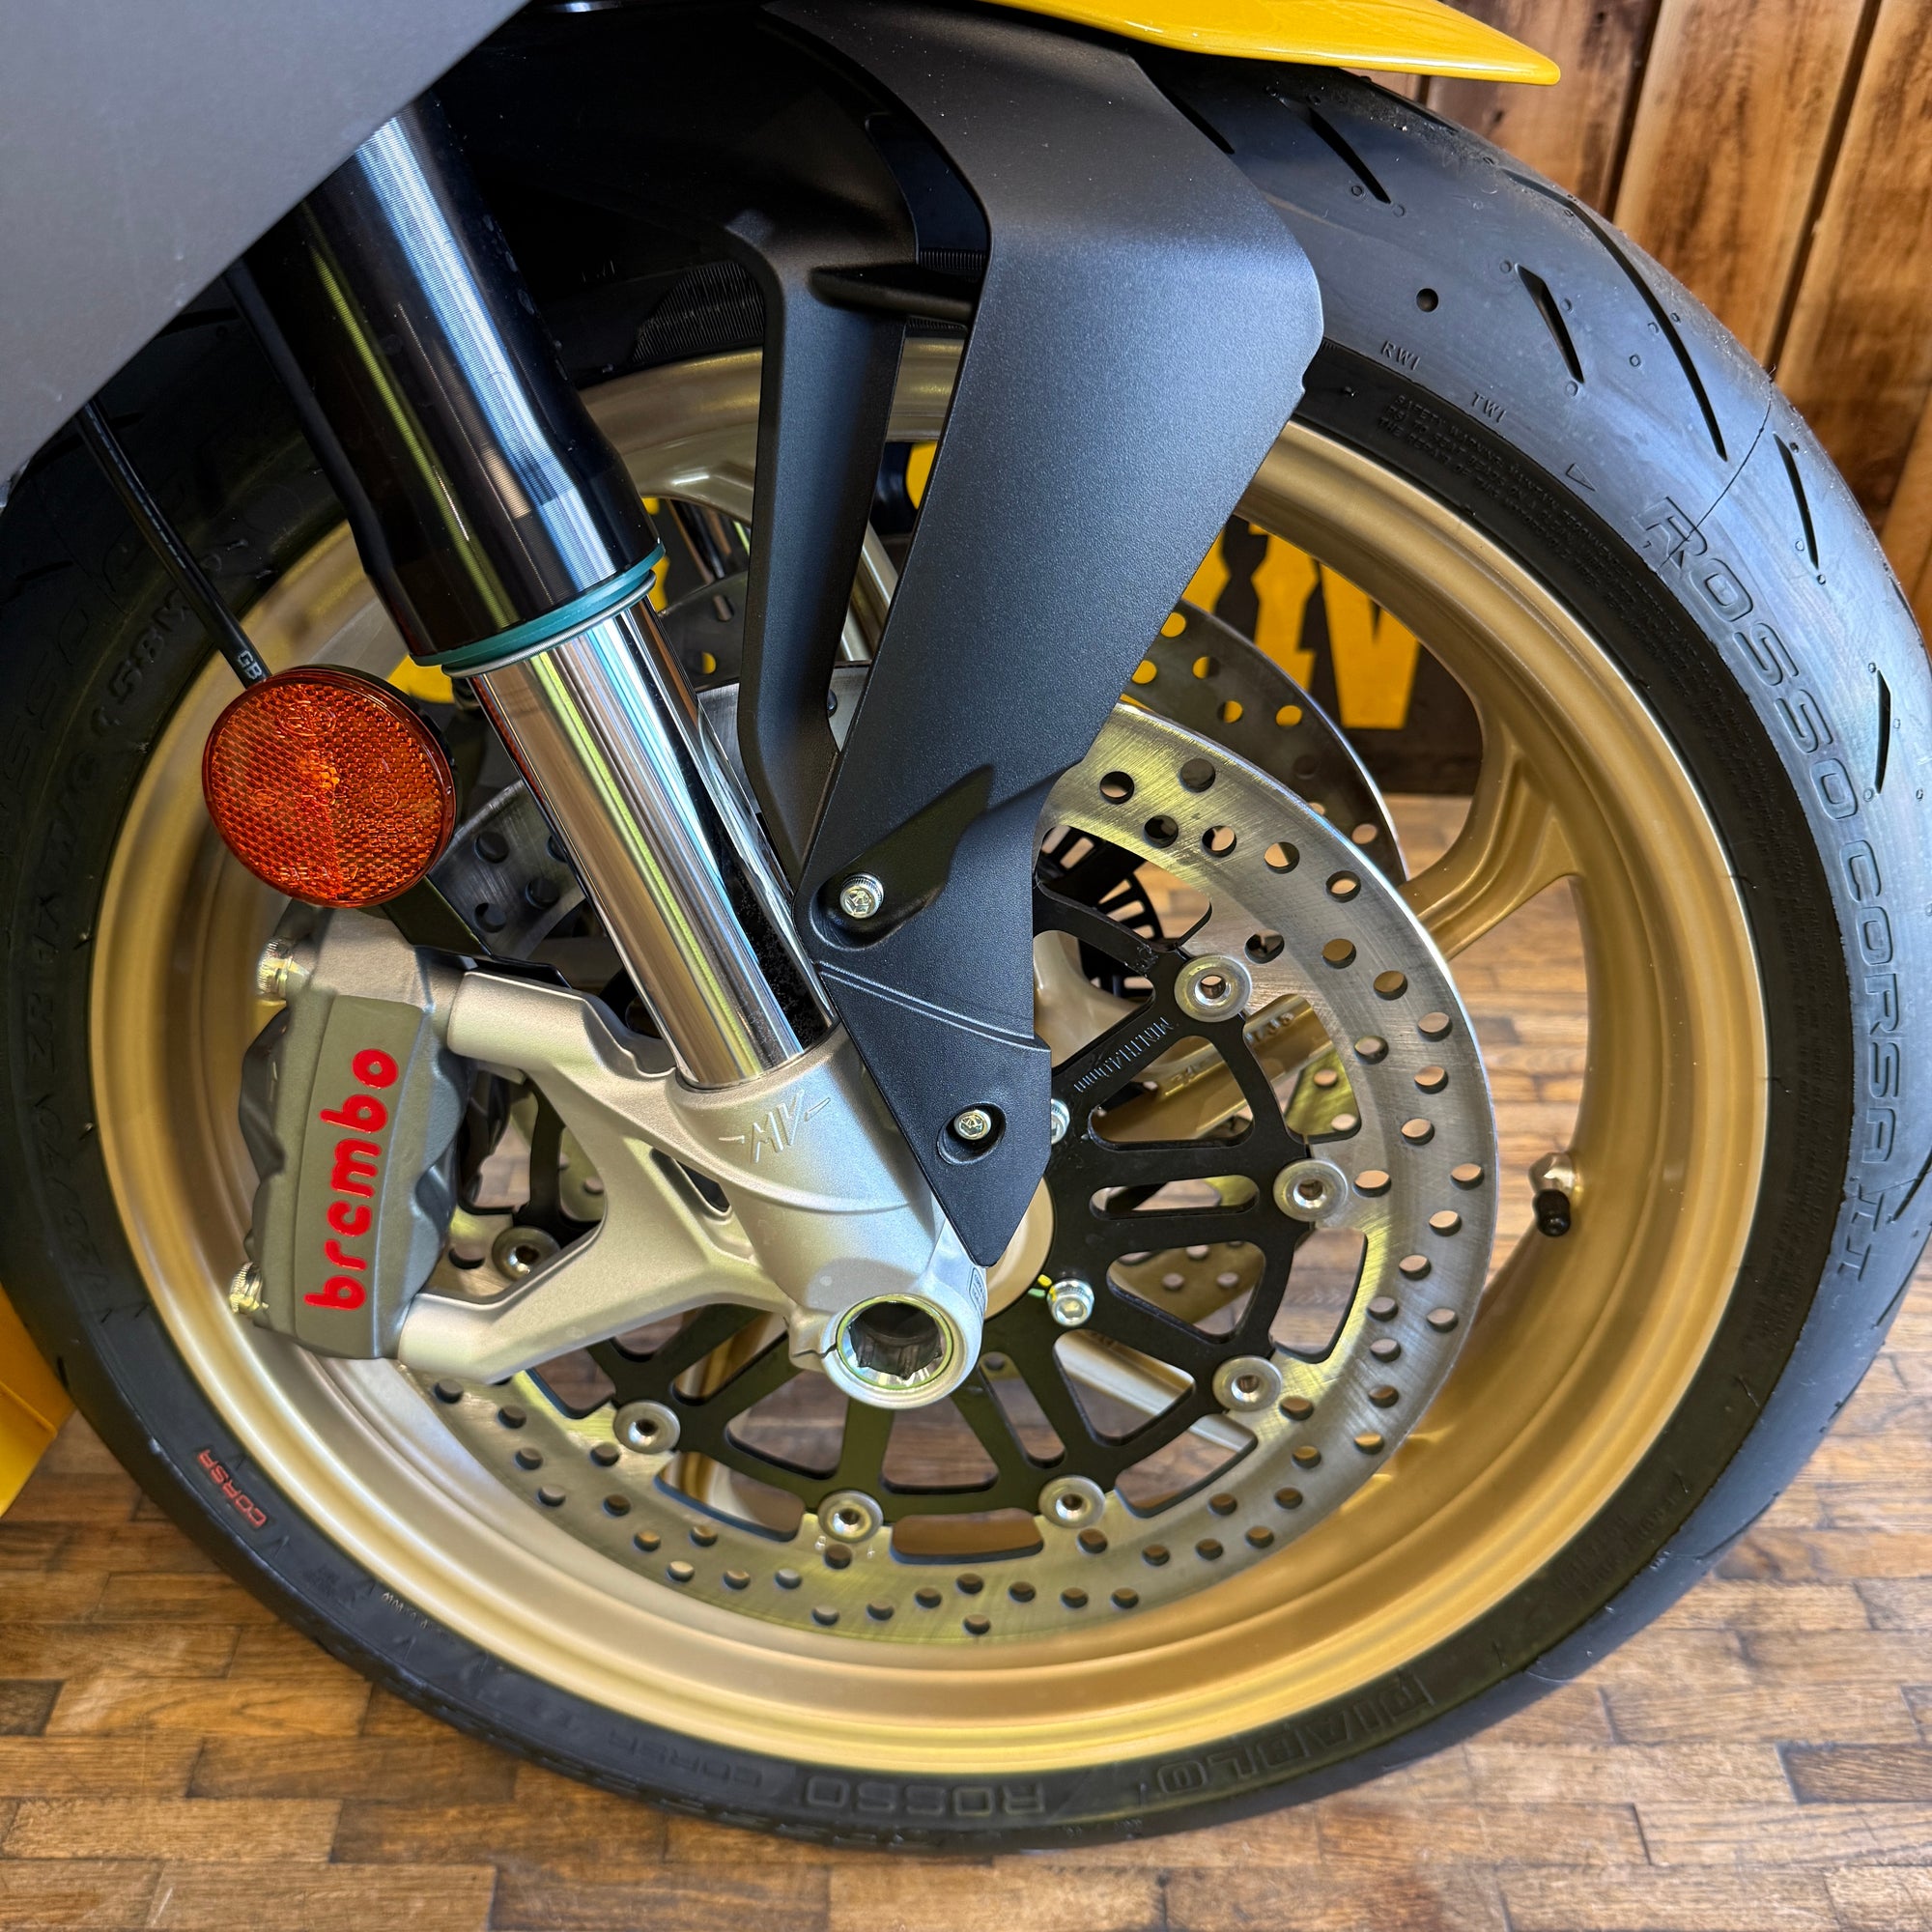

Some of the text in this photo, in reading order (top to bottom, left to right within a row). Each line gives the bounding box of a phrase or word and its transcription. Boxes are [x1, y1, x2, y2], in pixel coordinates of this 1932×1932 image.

[1380, 339, 1419, 371] RWI
[1471, 392, 1505, 423] TWI
[237, 649, 263, 680] GB
[1644, 496, 1859, 820] ROSSO
[1841, 838, 1901, 1164] CORSA
[303, 1048, 399, 1311] brembo
[196, 1447, 268, 1529] CORSA
[1157, 1669, 1435, 1794] DIABLO
[805, 1774, 1046, 1817] ROSSO
